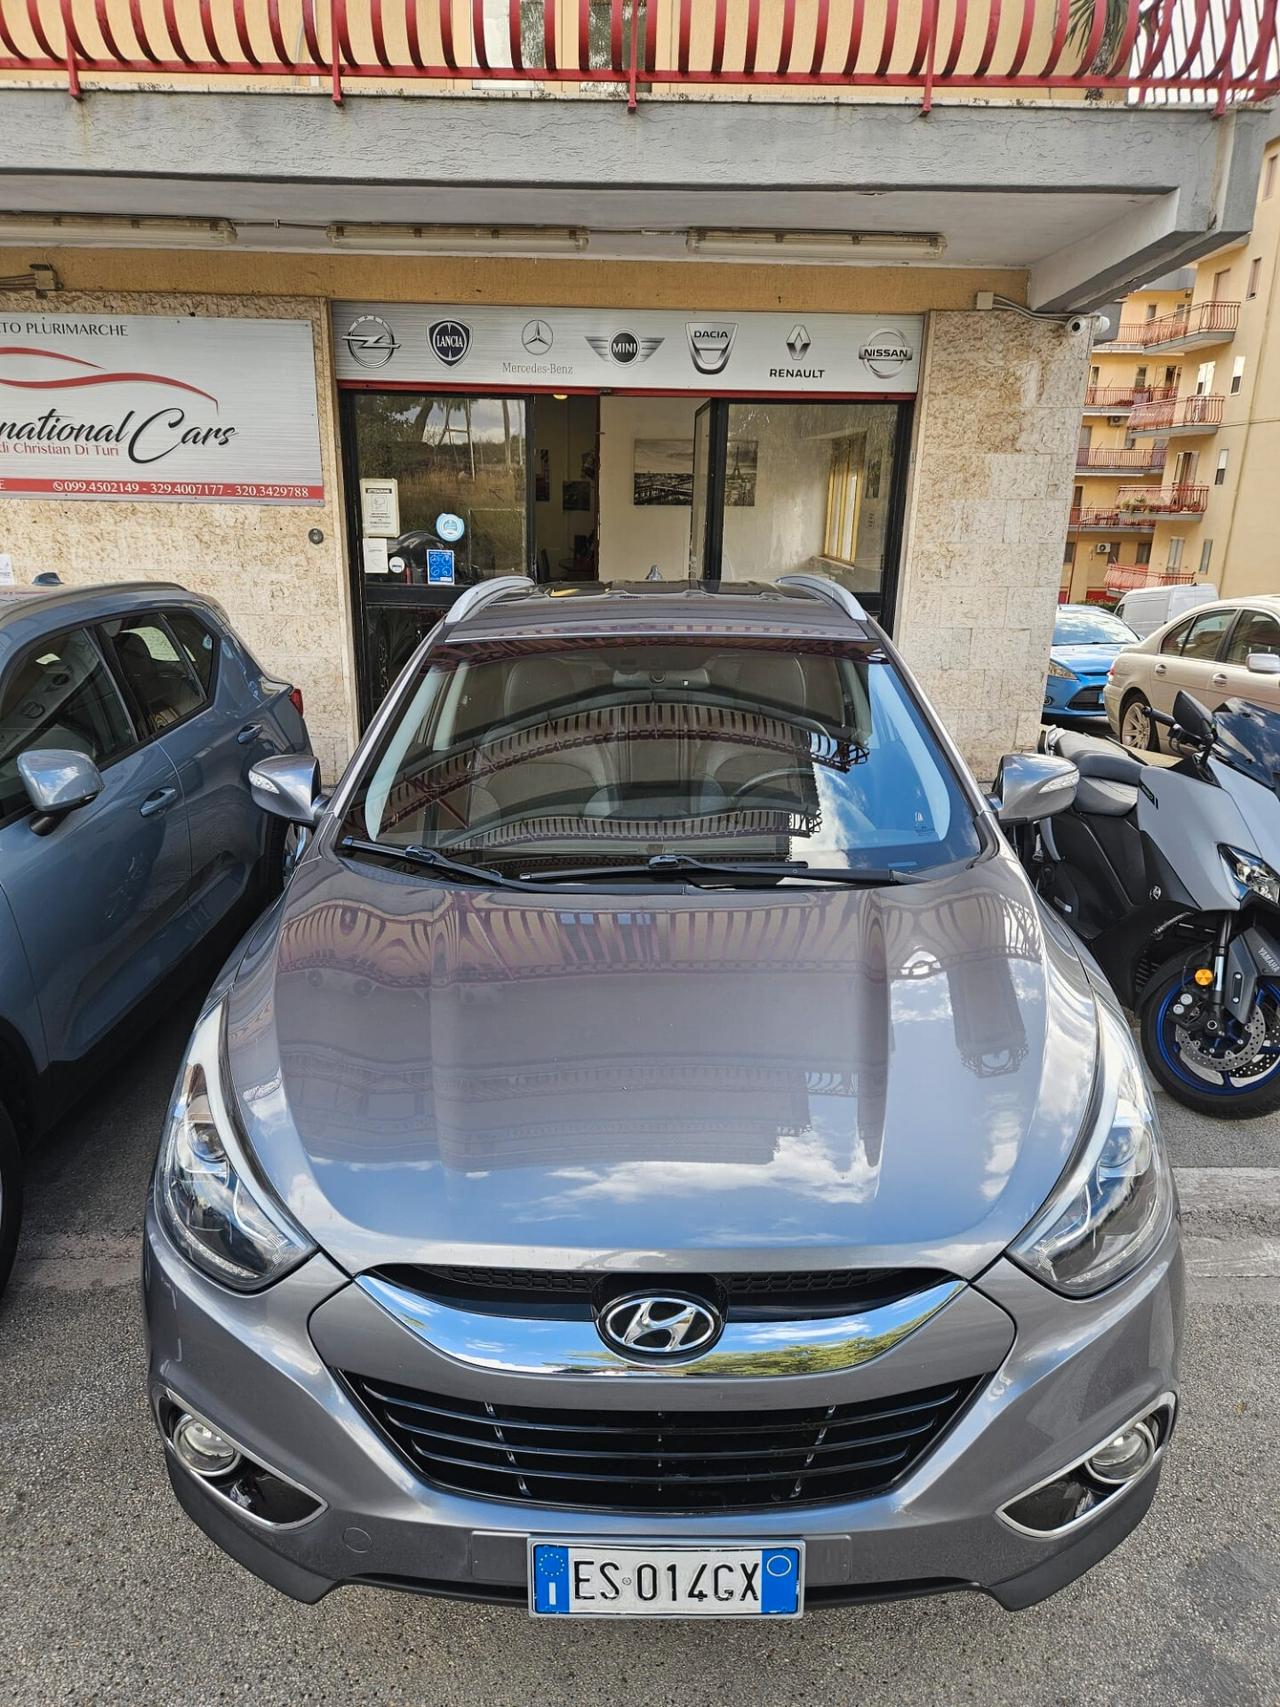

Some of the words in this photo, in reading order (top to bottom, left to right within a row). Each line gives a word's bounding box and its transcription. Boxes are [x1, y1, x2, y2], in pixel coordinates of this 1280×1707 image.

[26, 322, 129, 337] PLURIMARCHE
[693, 330, 729, 339] DACIA
[436, 335, 464, 348] LANCIA
[612, 342, 637, 353] MINI
[863, 348, 908, 358] NISSAN
[502, 362, 574, 375] Mercedes-Benz
[769, 368, 825, 379] RENAULT
[128, 407, 238, 464] Cars
[13, 441, 71, 455] Christian
[75, 443, 89, 455] Di
[94, 443, 120, 457] Turi
[64, 481, 139, 493] 099.4502149
[150, 483, 224, 495] 329.4007177
[235, 485, 309, 498] 320.3429788
